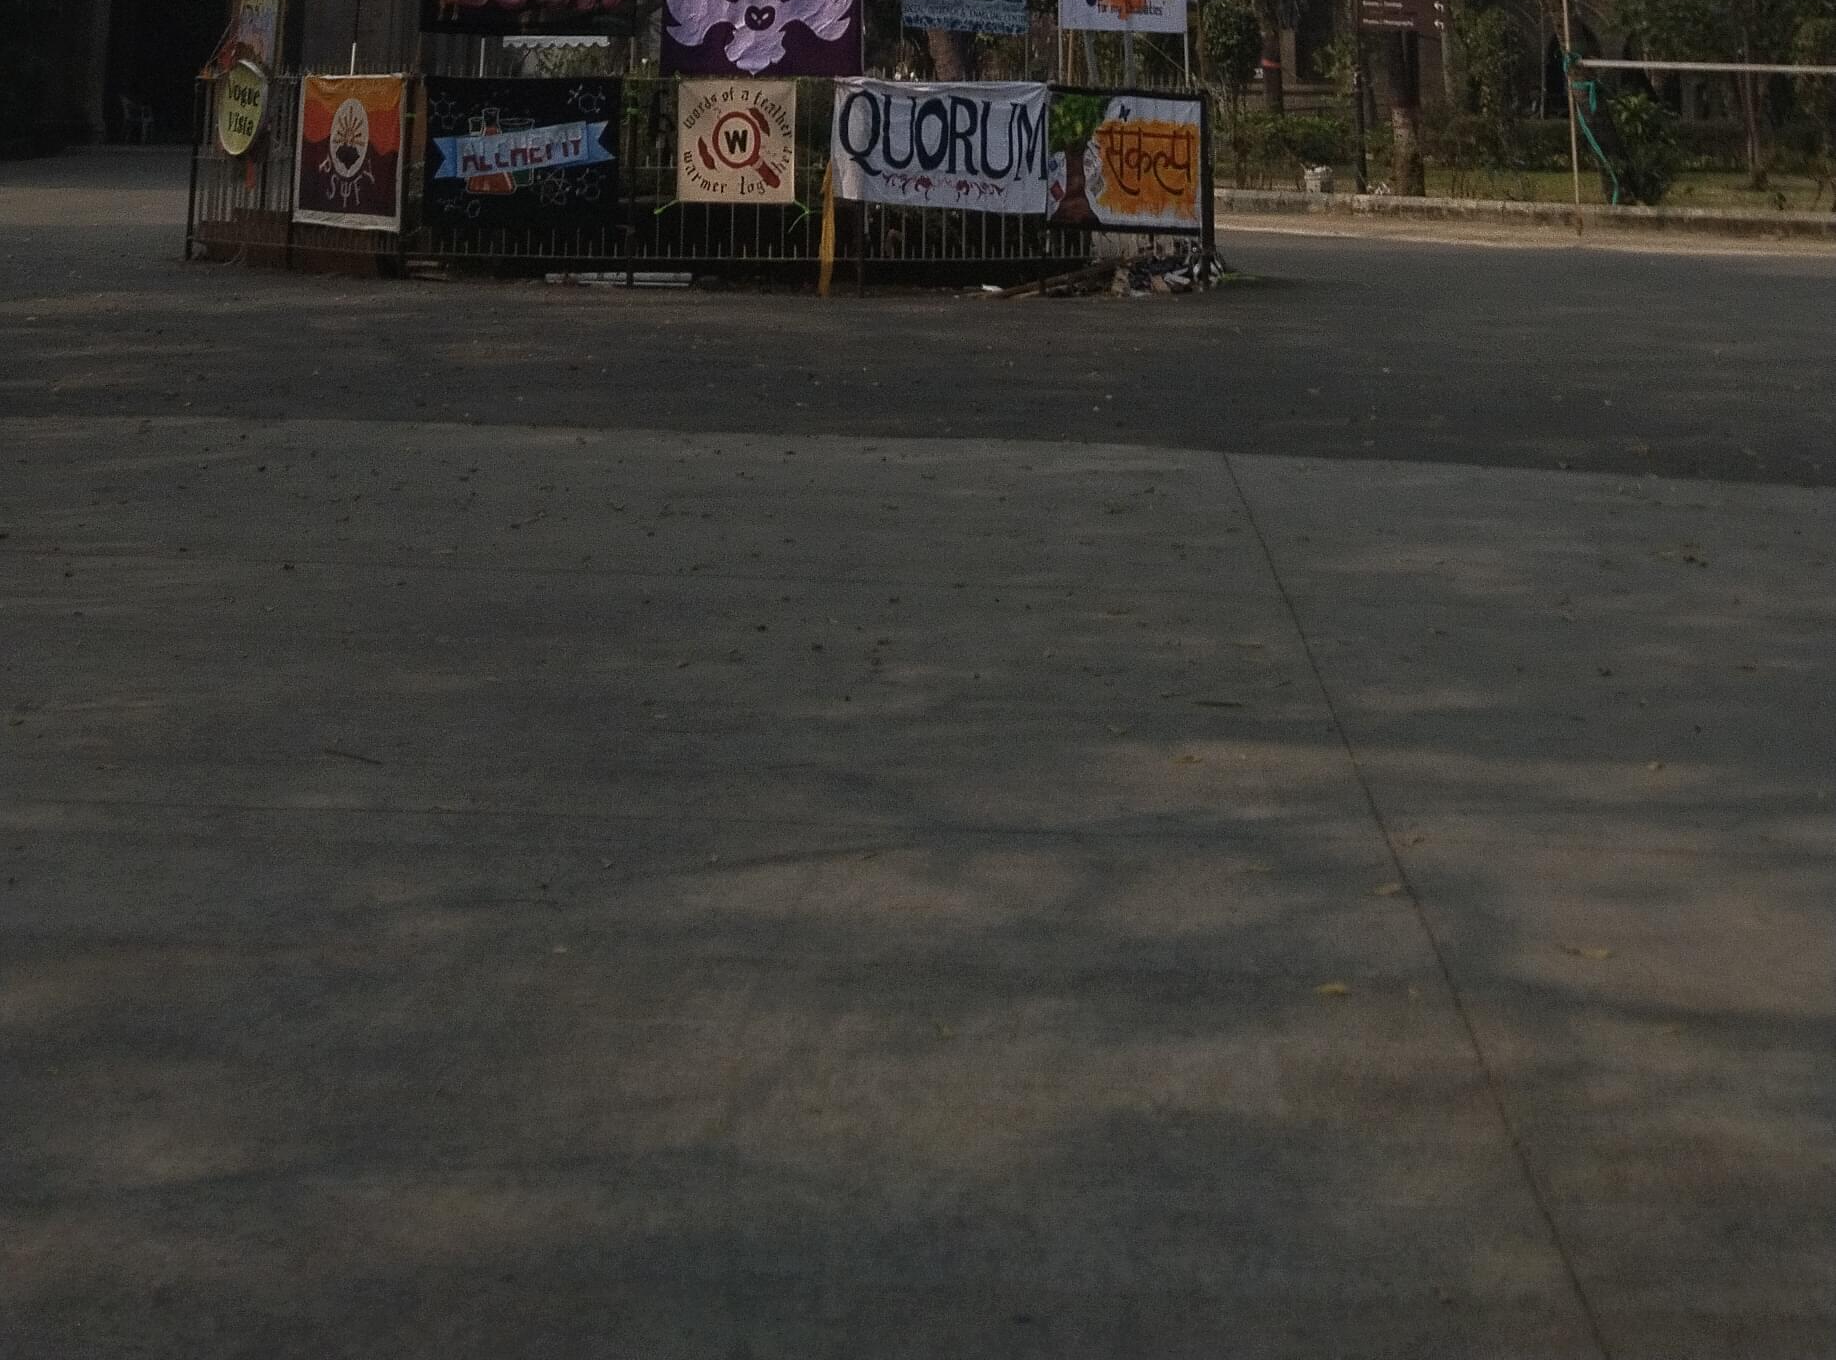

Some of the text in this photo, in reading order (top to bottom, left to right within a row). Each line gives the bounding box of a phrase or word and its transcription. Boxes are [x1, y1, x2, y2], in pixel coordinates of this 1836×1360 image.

[682, 86, 793, 138] words of a feather
[839, 90, 1047, 181] QUORUM
[724, 129, 748, 155] W
